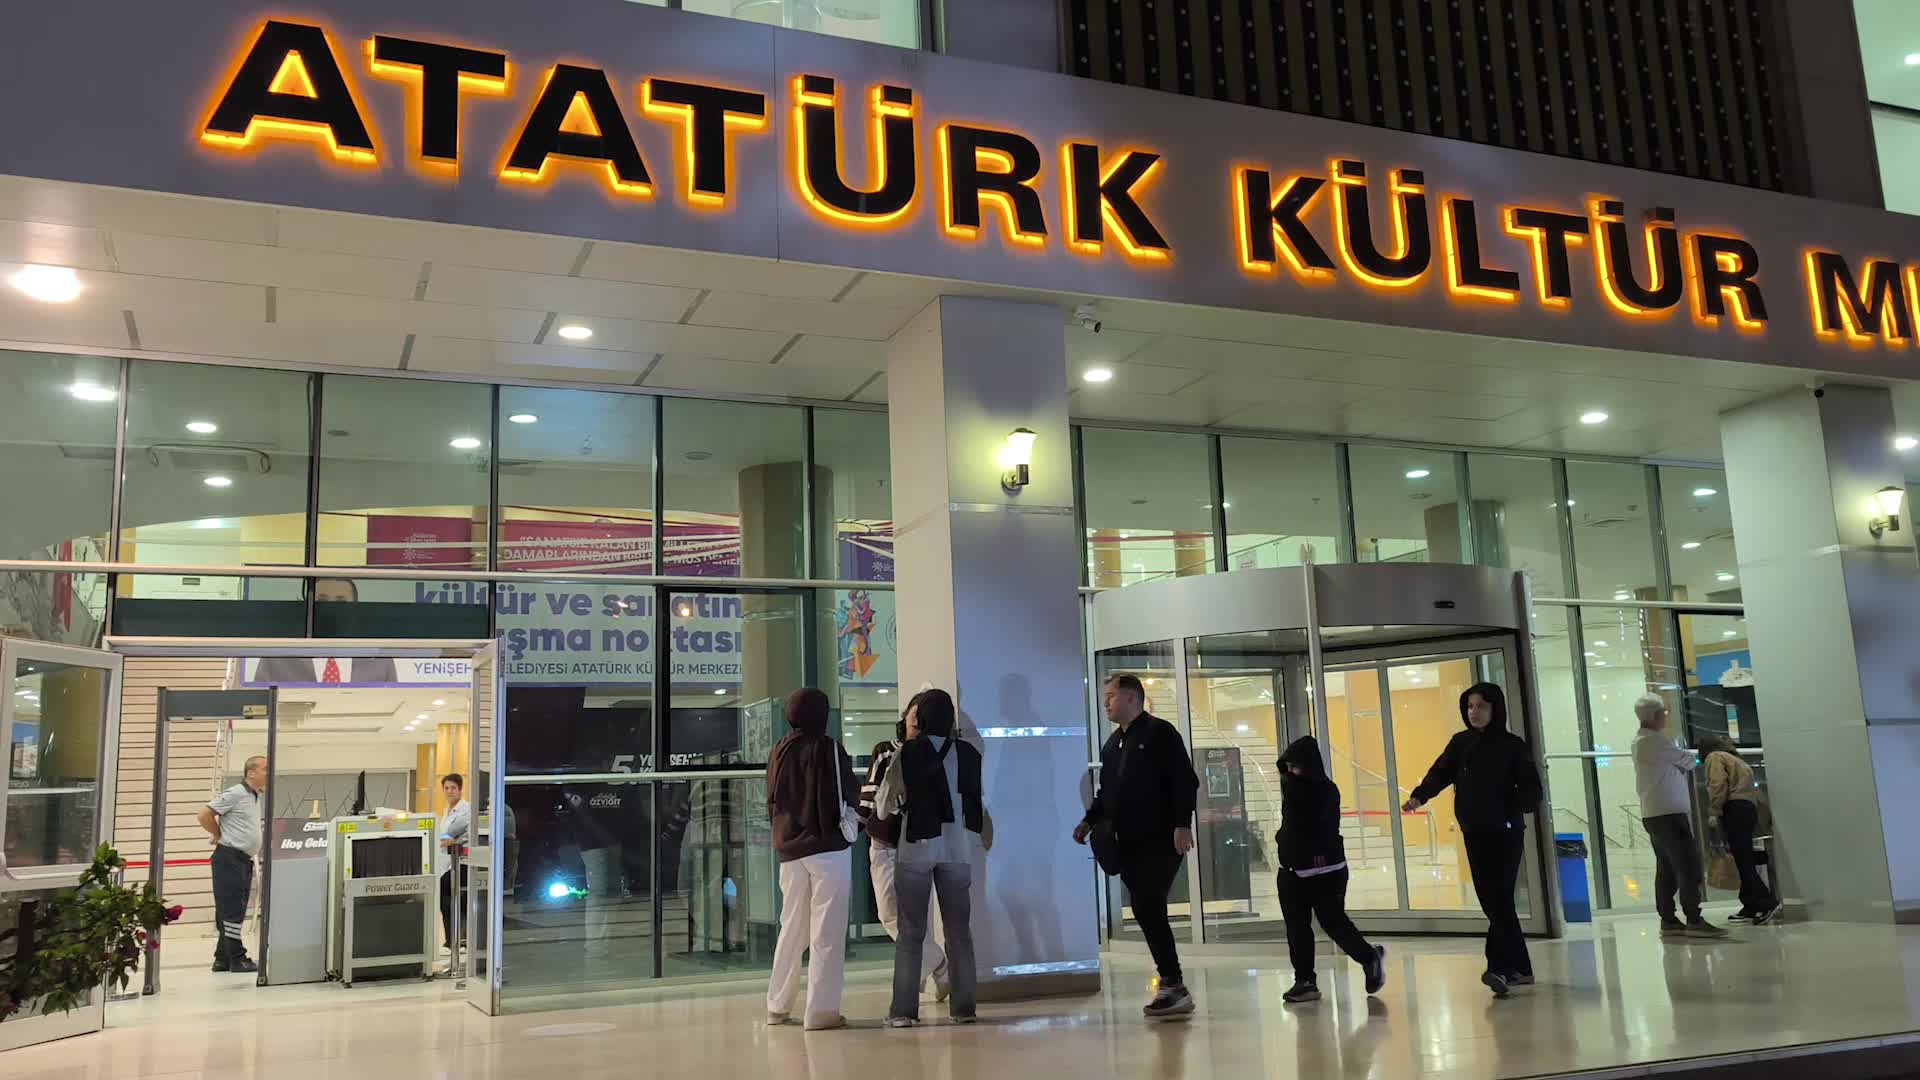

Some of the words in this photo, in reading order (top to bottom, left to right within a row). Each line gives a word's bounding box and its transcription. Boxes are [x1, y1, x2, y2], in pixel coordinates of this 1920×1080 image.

[202, 20, 1172, 260] ATATÜRK
[1238, 159, 1767, 327] KÜLTÜR
[1806, 250, 1920, 345] M
[546, 593, 594, 617] ve
[602, 591, 742, 619] saatın
[602, 626, 743, 654] notası
[572, 661, 632, 675] ATATÜRK
[365, 884, 392, 893] Power
[393, 883, 419, 892] Guard
